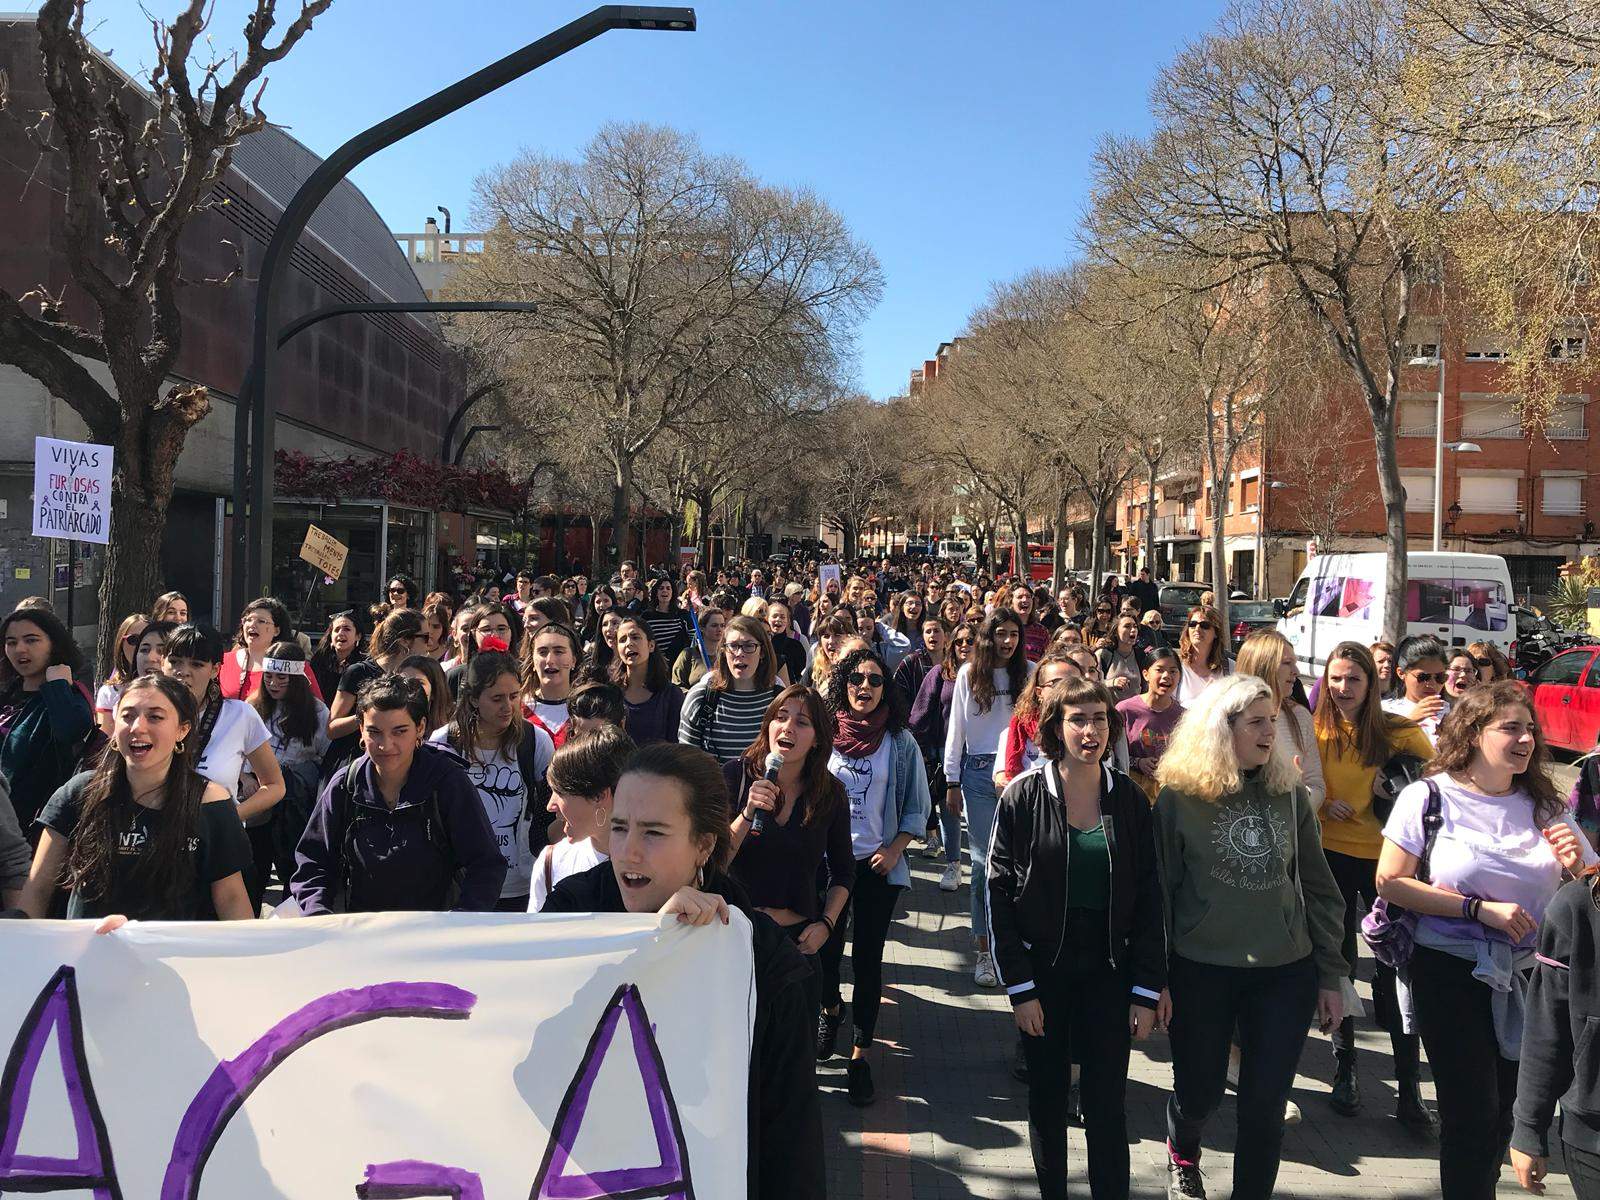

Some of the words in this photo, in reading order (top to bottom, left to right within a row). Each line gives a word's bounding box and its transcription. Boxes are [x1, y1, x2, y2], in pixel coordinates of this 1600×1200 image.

[51, 446, 99, 467] VIVAS
[70, 464, 77, 476] Y
[52, 490, 88, 505] CONTRA
[66, 503, 77, 511] EL
[40, 506, 102, 535] PATRIARCADO
